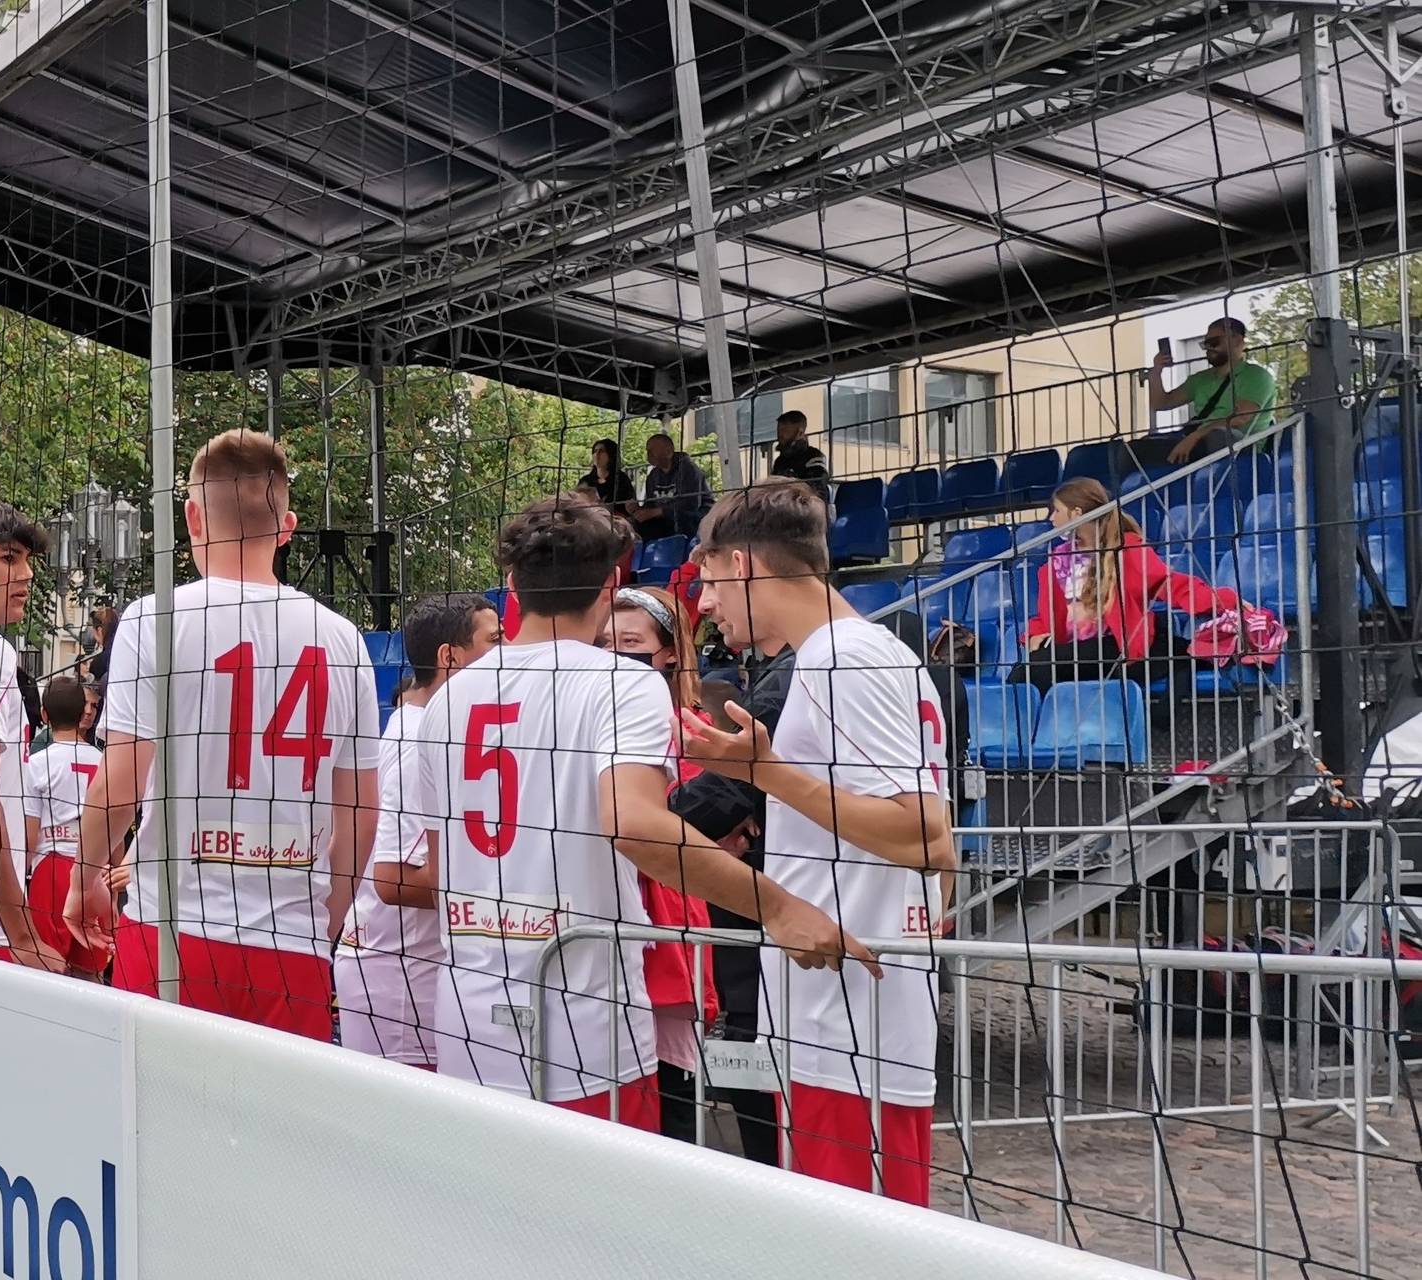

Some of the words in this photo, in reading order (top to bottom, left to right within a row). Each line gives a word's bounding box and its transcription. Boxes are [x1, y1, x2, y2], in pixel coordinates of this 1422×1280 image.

[215, 642, 333, 792] 14
[464, 702, 521, 858] 5
[191, 830, 245, 856] LEBE
[249, 844, 278, 860] wie
[282, 838, 304, 865] du
